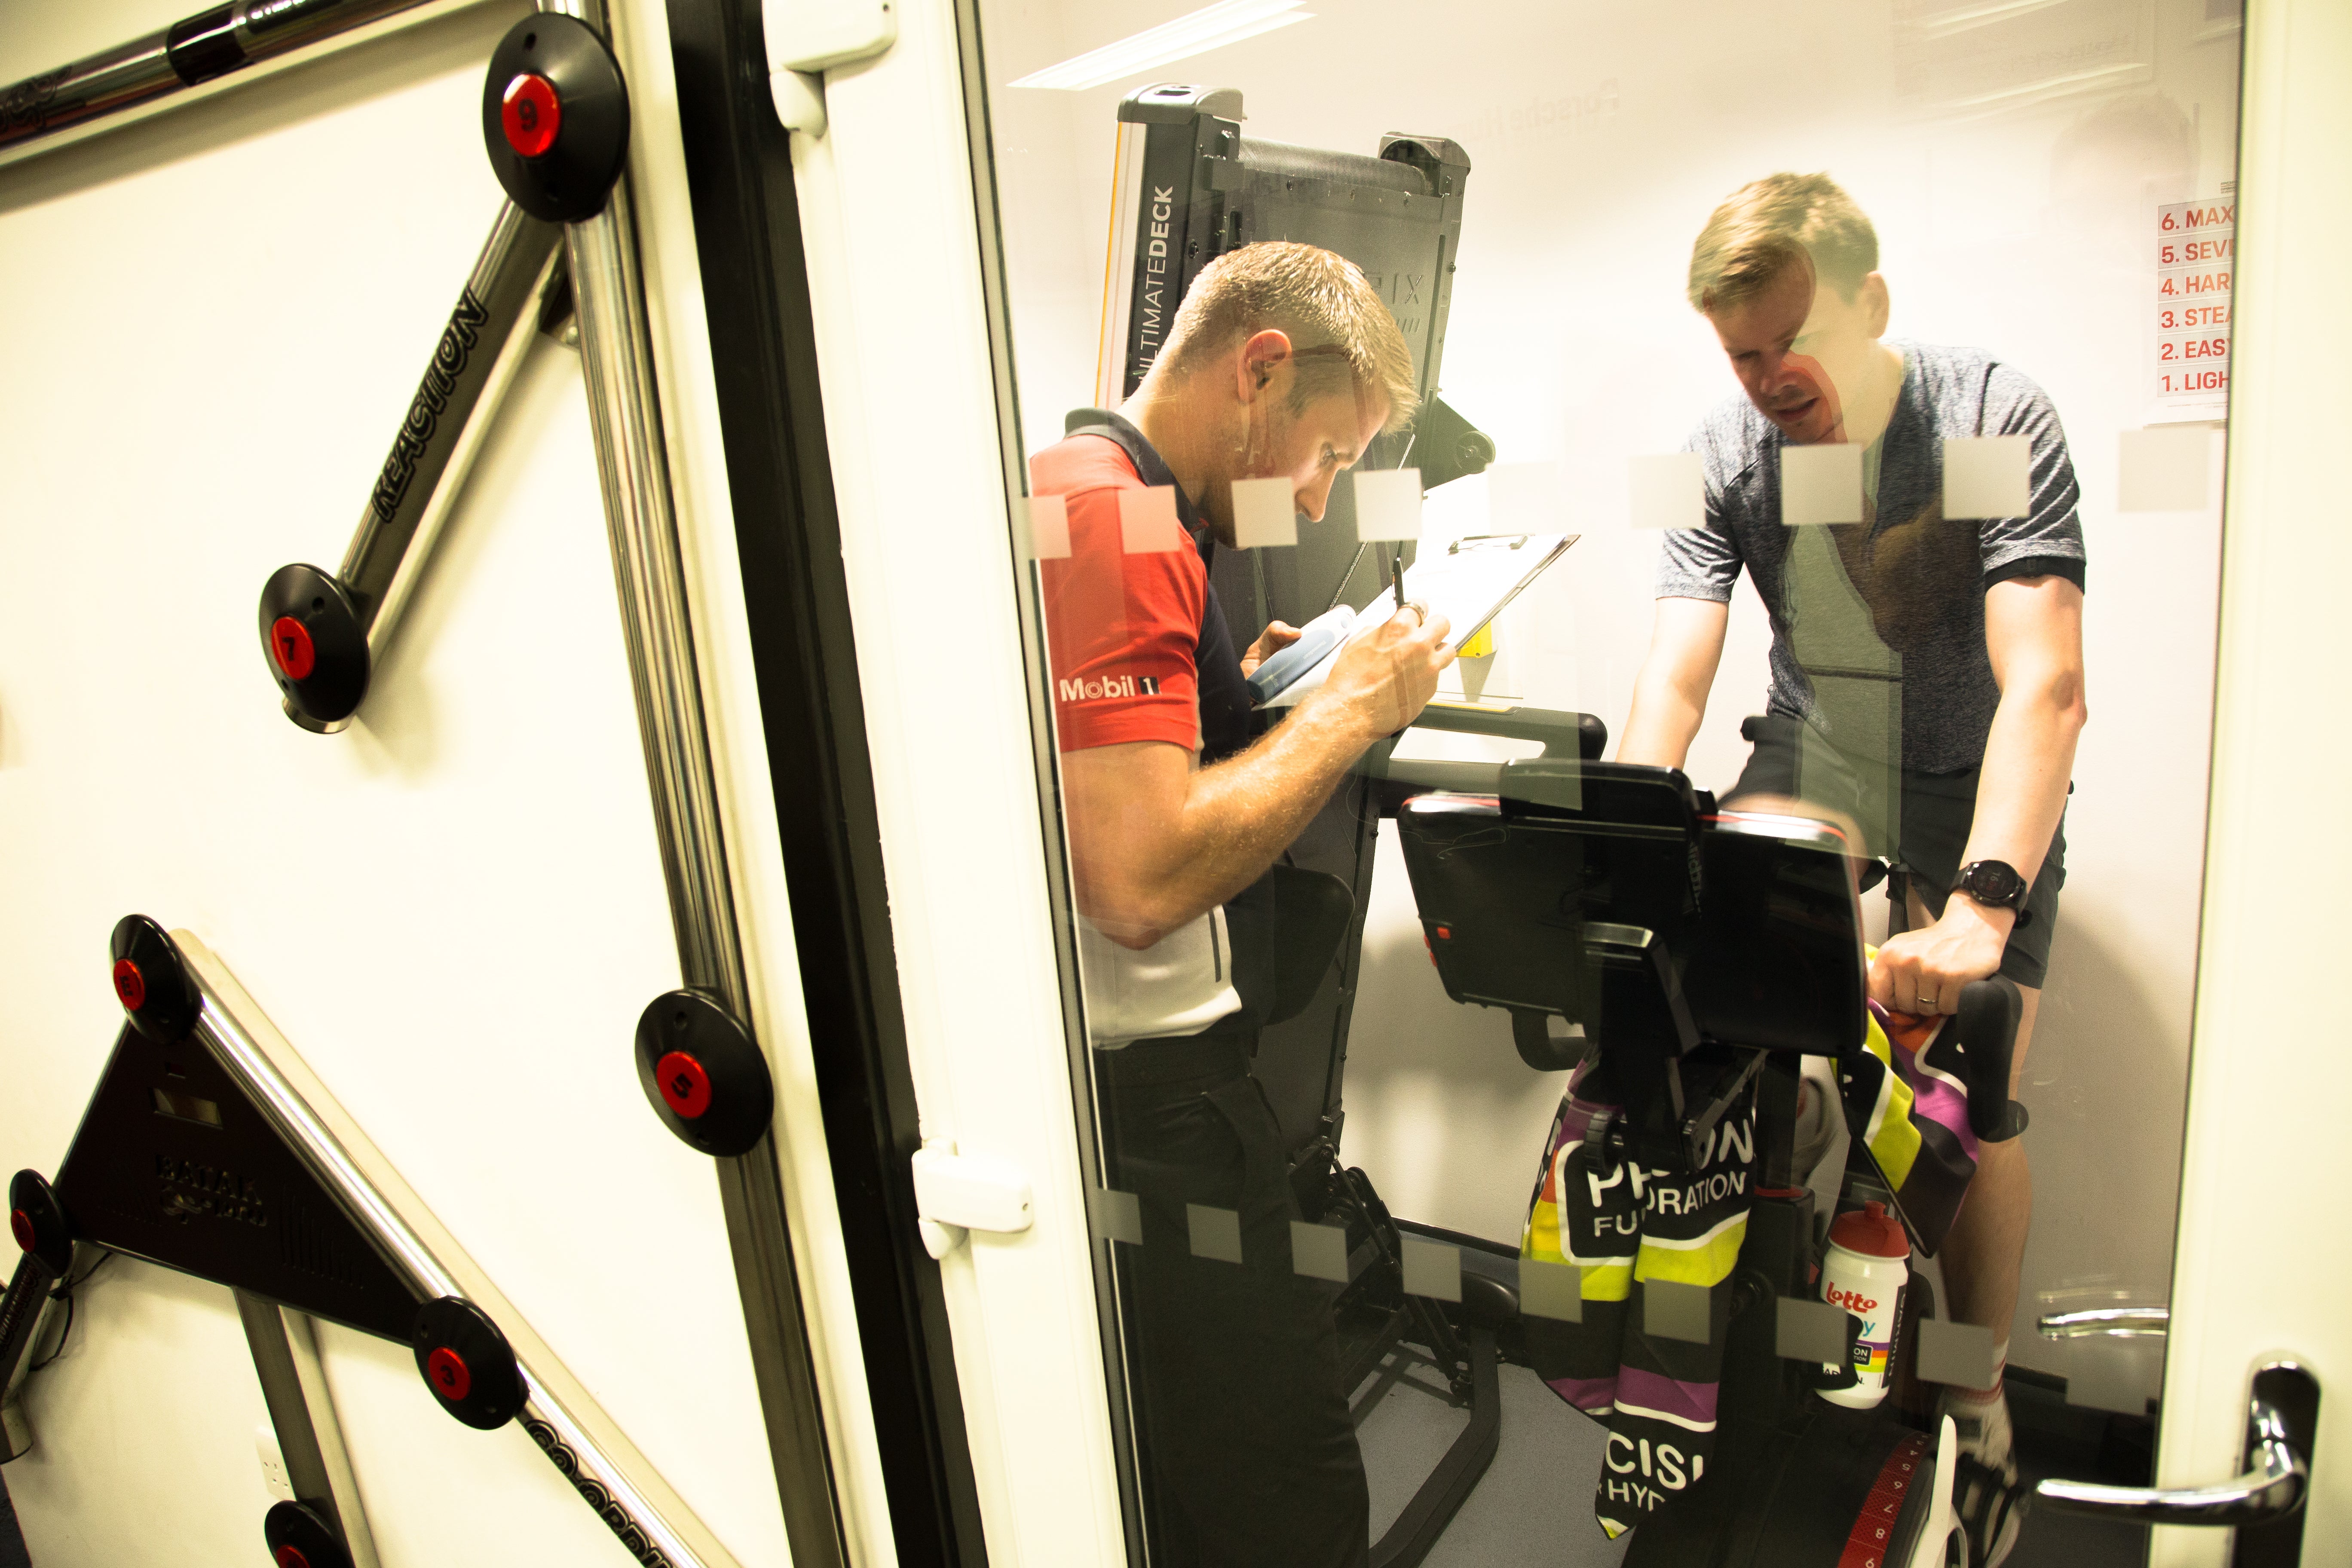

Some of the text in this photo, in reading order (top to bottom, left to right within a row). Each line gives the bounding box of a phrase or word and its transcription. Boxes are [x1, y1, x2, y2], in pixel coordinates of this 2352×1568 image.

[518, 98, 537, 132] 9
[2161, 205, 2235, 231] 6. MAX
[2161, 245, 2180, 264] 5.
[2161, 273, 2230, 296] 4. HAR
[2161, 310, 2179, 328] 3.
[2161, 343, 2179, 361] 2.
[2161, 375, 2178, 392] 1.
[371, 282, 488, 523] REACTION
[282, 636, 295, 661] 7
[1059, 675, 1155, 701] Mobil 1
[671, 1073, 693, 1099] 5
[1826, 1281, 1878, 1314] lotto
[440, 1365, 456, 1387] 3
[1884, 1504, 1893, 1513] 7
[1875, 1528, 1885, 1539] 8
